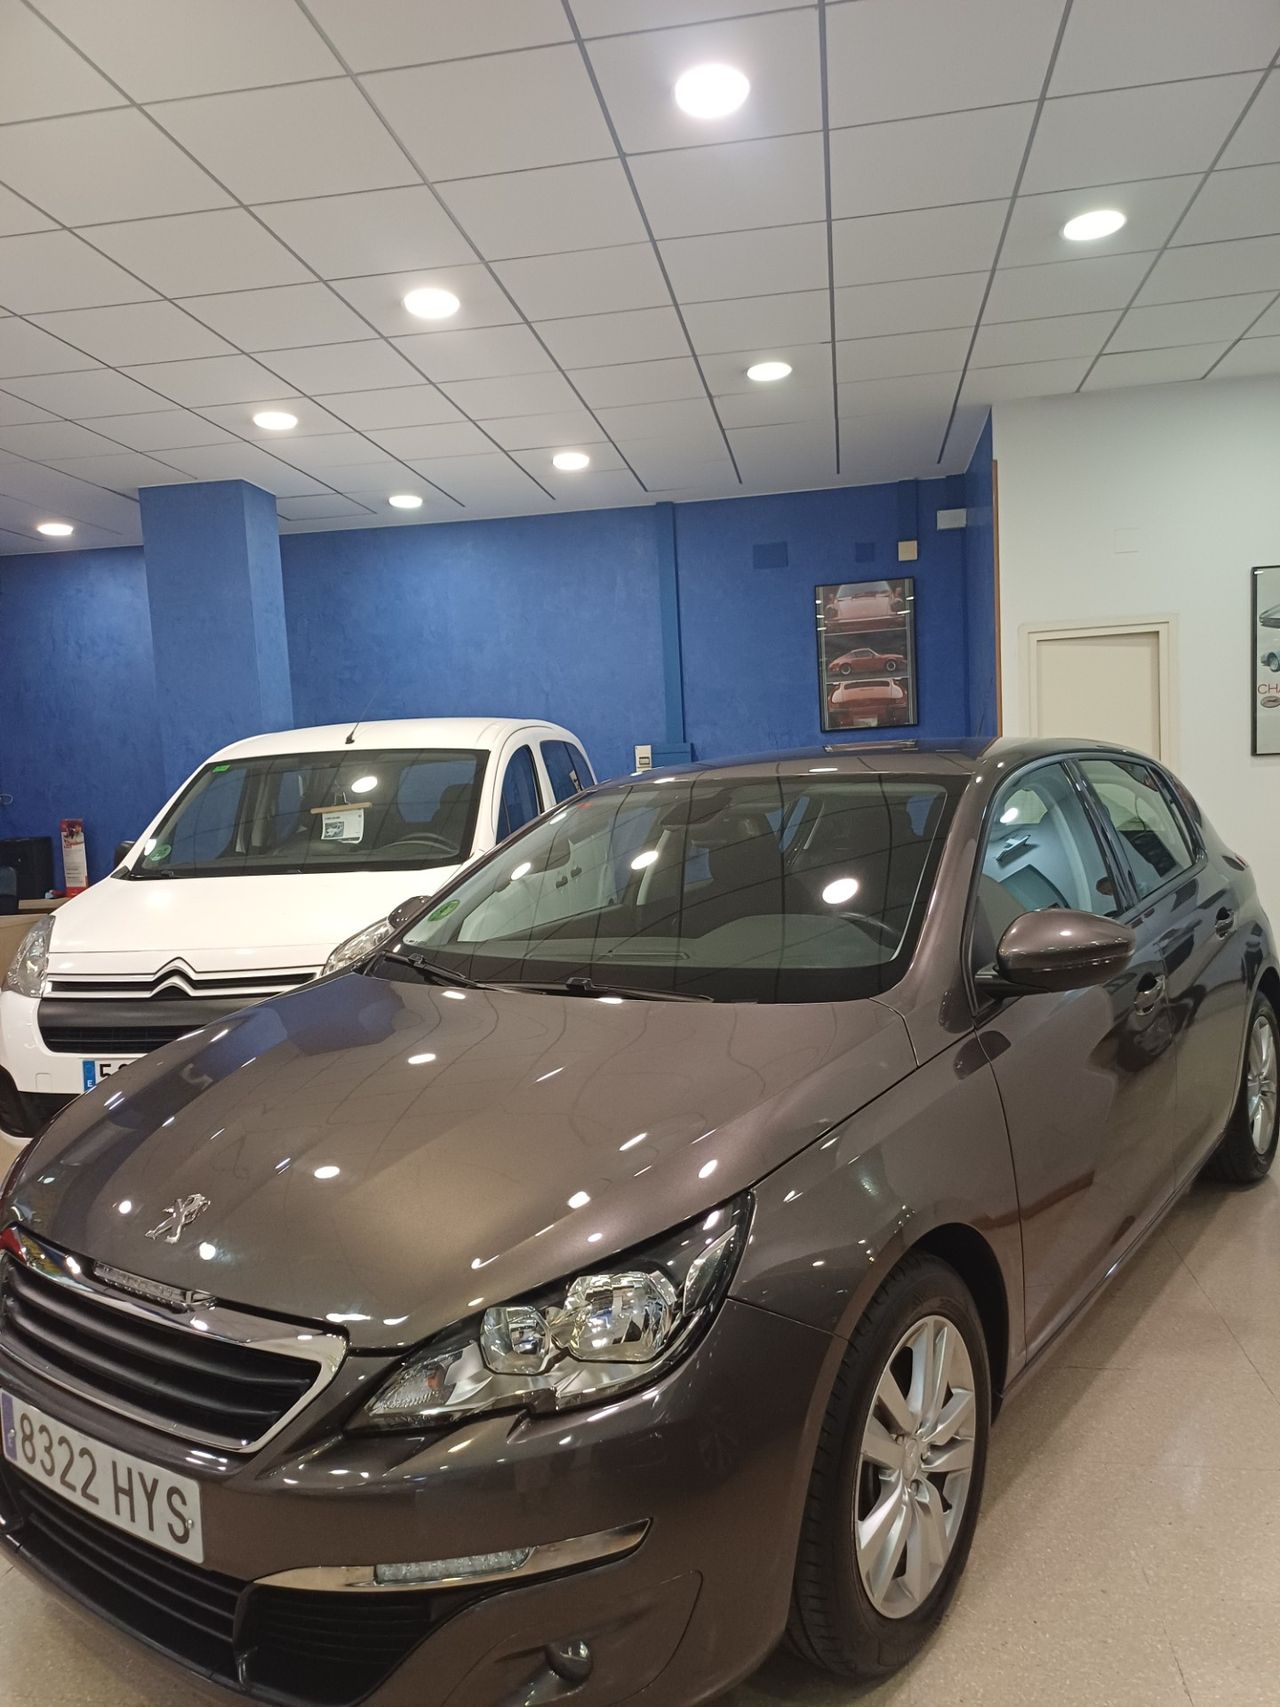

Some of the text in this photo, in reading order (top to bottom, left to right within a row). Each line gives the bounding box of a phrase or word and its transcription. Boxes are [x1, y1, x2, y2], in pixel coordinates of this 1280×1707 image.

[1257, 683, 1280, 695] CH
[99, 1063, 129, 1078] 5
[87, 1079, 93, 1087] E
[20, 1412, 190, 1545] 8322 HYS
